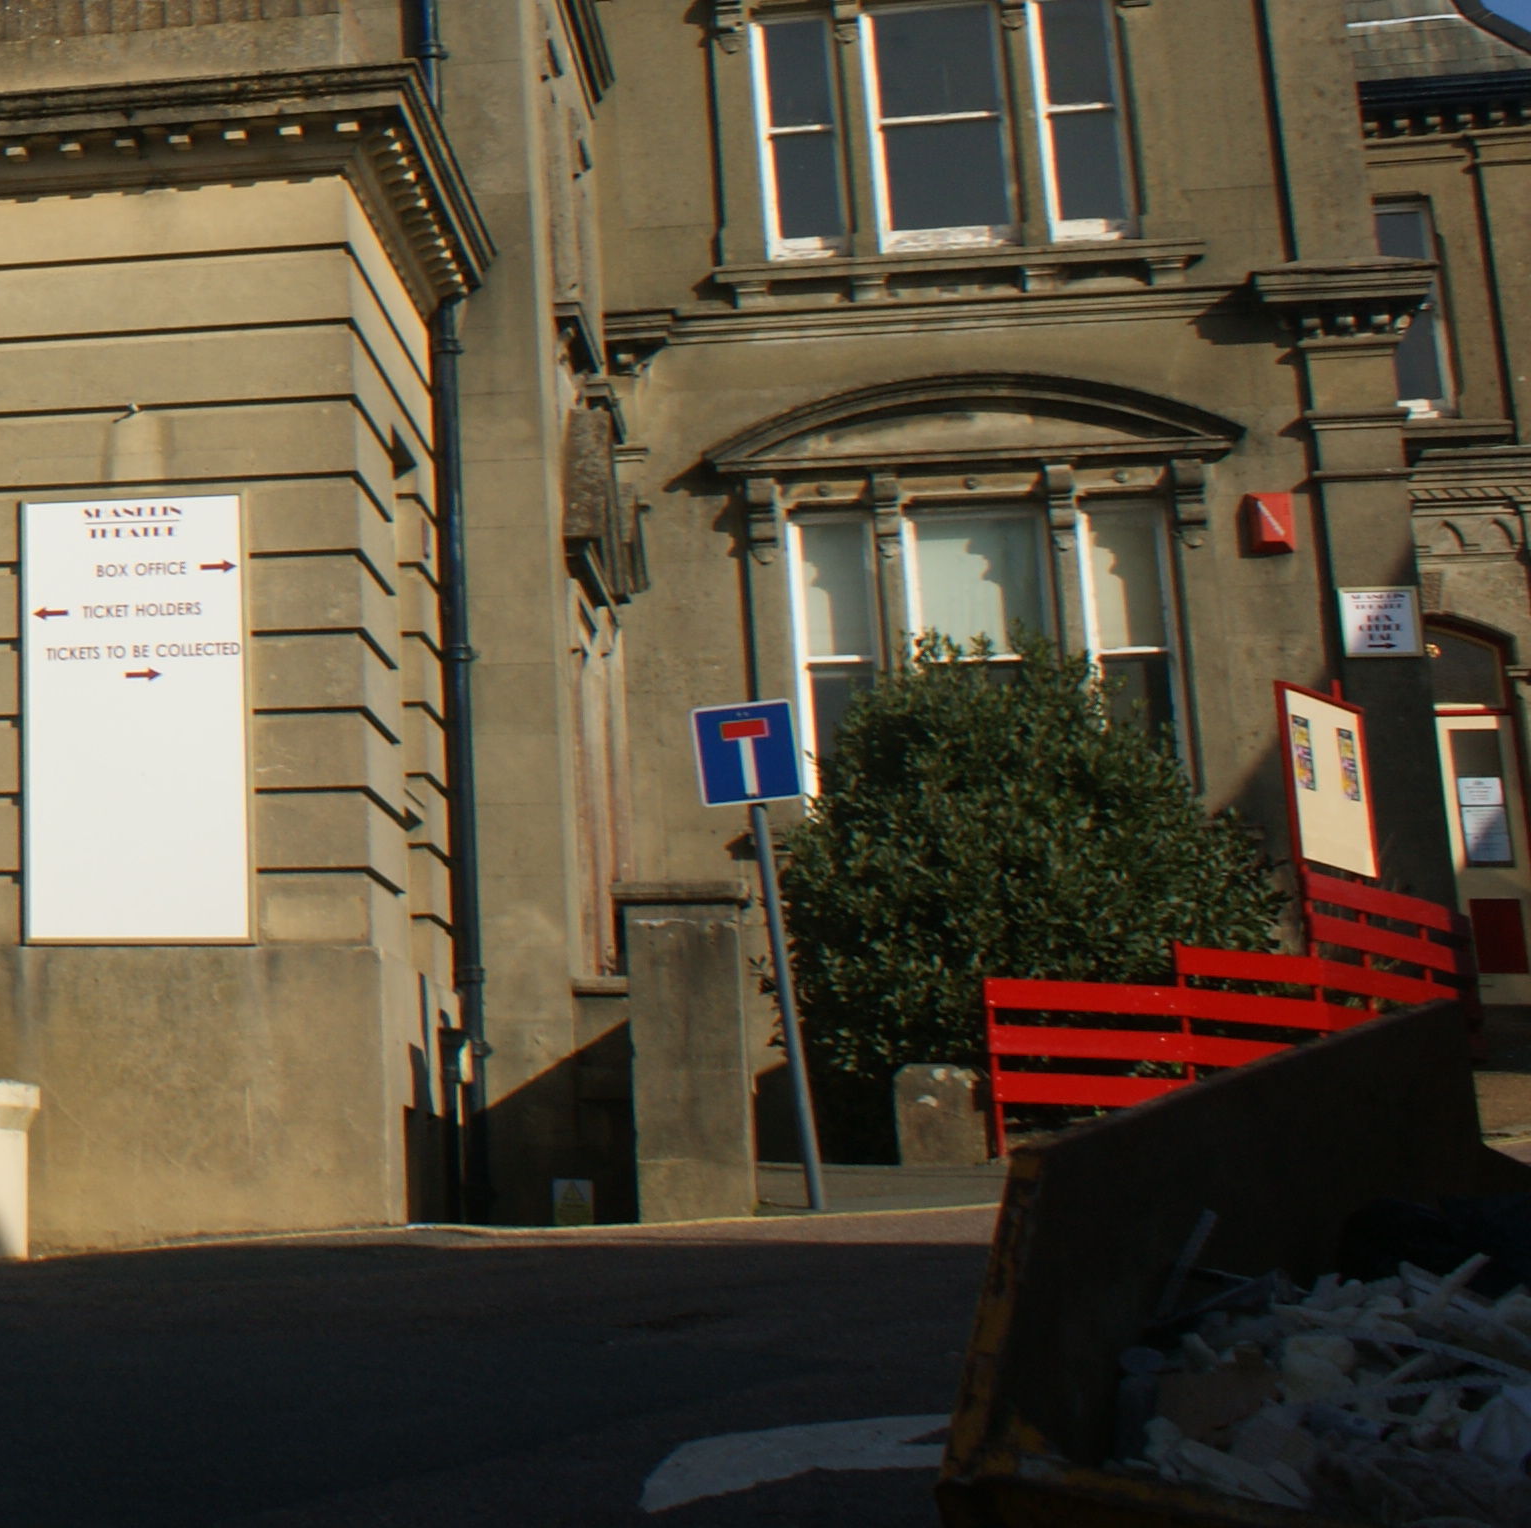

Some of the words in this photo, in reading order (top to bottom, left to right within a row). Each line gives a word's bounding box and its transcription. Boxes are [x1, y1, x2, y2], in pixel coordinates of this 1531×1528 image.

[82, 505, 182, 519] SHANKLIN
[87, 526, 178, 539] THEATRE
[96, 563, 129, 577] BOX
[135, 561, 187, 576] OFFICE
[82, 604, 129, 619] TICKET
[135, 602, 202, 617] HOLDERS
[1366, 614, 1393, 622] BOX
[1358, 624, 1401, 632] OFFICE
[46, 646, 101, 661] TICKETS
[107, 645, 127, 660] TO
[132, 644, 150, 658] BE
[155, 642, 240, 657] COLLECTED
